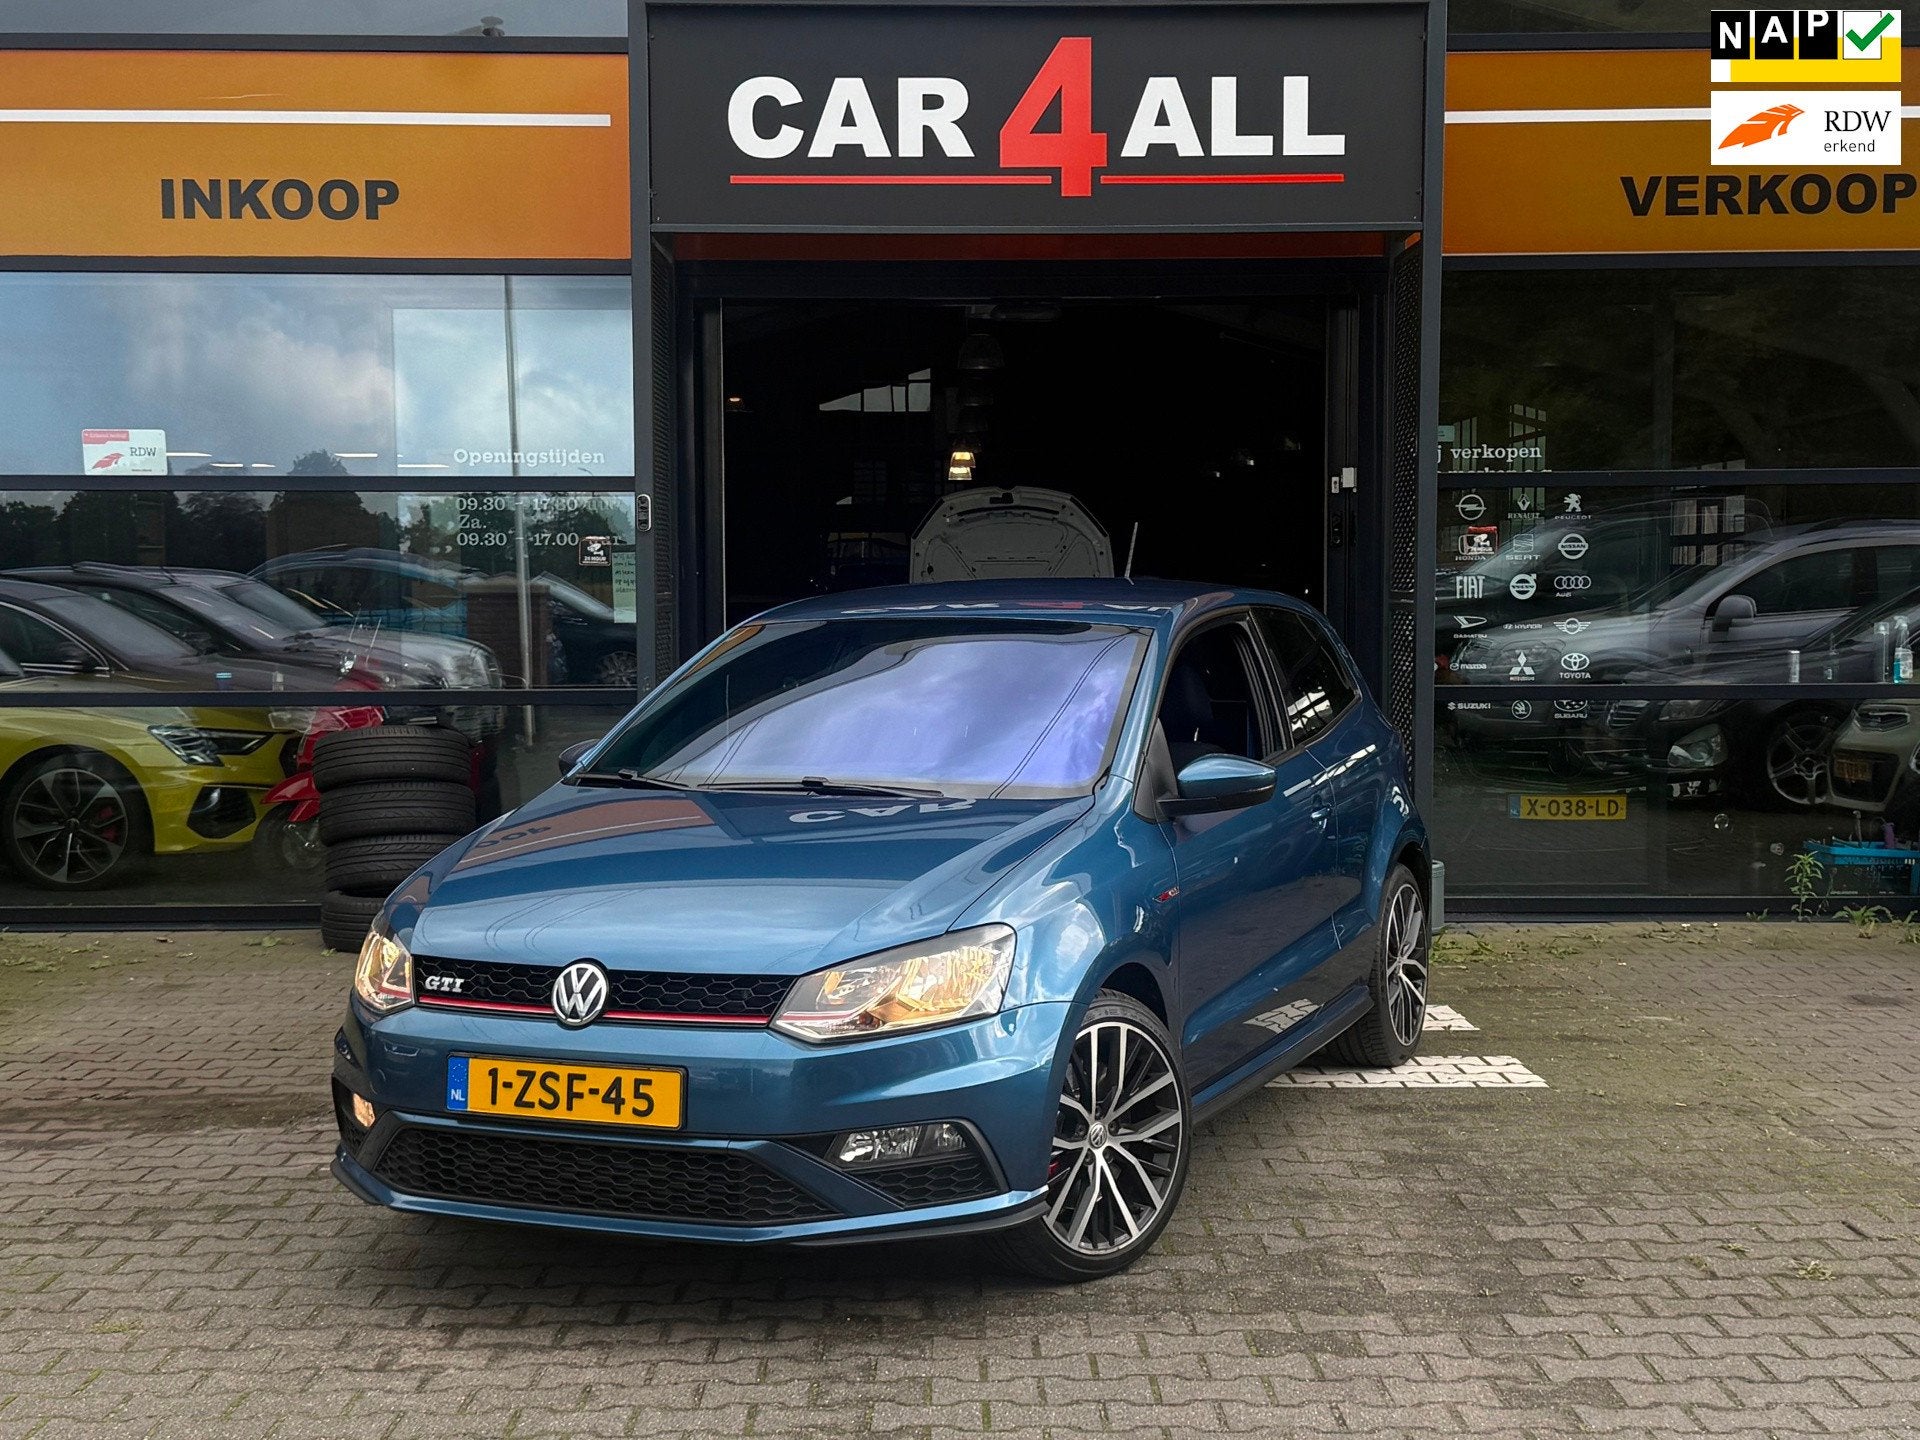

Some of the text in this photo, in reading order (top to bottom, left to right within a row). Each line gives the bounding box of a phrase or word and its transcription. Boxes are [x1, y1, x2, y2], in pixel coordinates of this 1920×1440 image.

[727, 37, 1346, 197] CAR 4 ALL
[161, 178, 400, 220] INKOOP
[1620, 173, 1918, 216] VERKOOP
[130, 447, 157, 457] RDW
[453, 448, 606, 467] Openingstijden
[1450, 444, 1543, 463] verkopen
[456, 497, 506, 512] 09.30
[458, 514, 487, 529] Za.
[1508, 512, 1540, 520] RENAULT
[456, 532, 508, 547] 09.30
[533, 532, 580, 547] 17.00
[1455, 575, 1486, 599] FIAT
[1559, 671, 1591, 680] TOYOTA
[1457, 702, 1491, 710] SUZUKI
[1554, 712, 1588, 720] SUBARU
[1526, 799, 1620, 818] X-038-LD
[425, 975, 464, 993] GTI
[451, 1088, 466, 1101] NL
[487, 1067, 655, 1118] 1-ZSF-45
